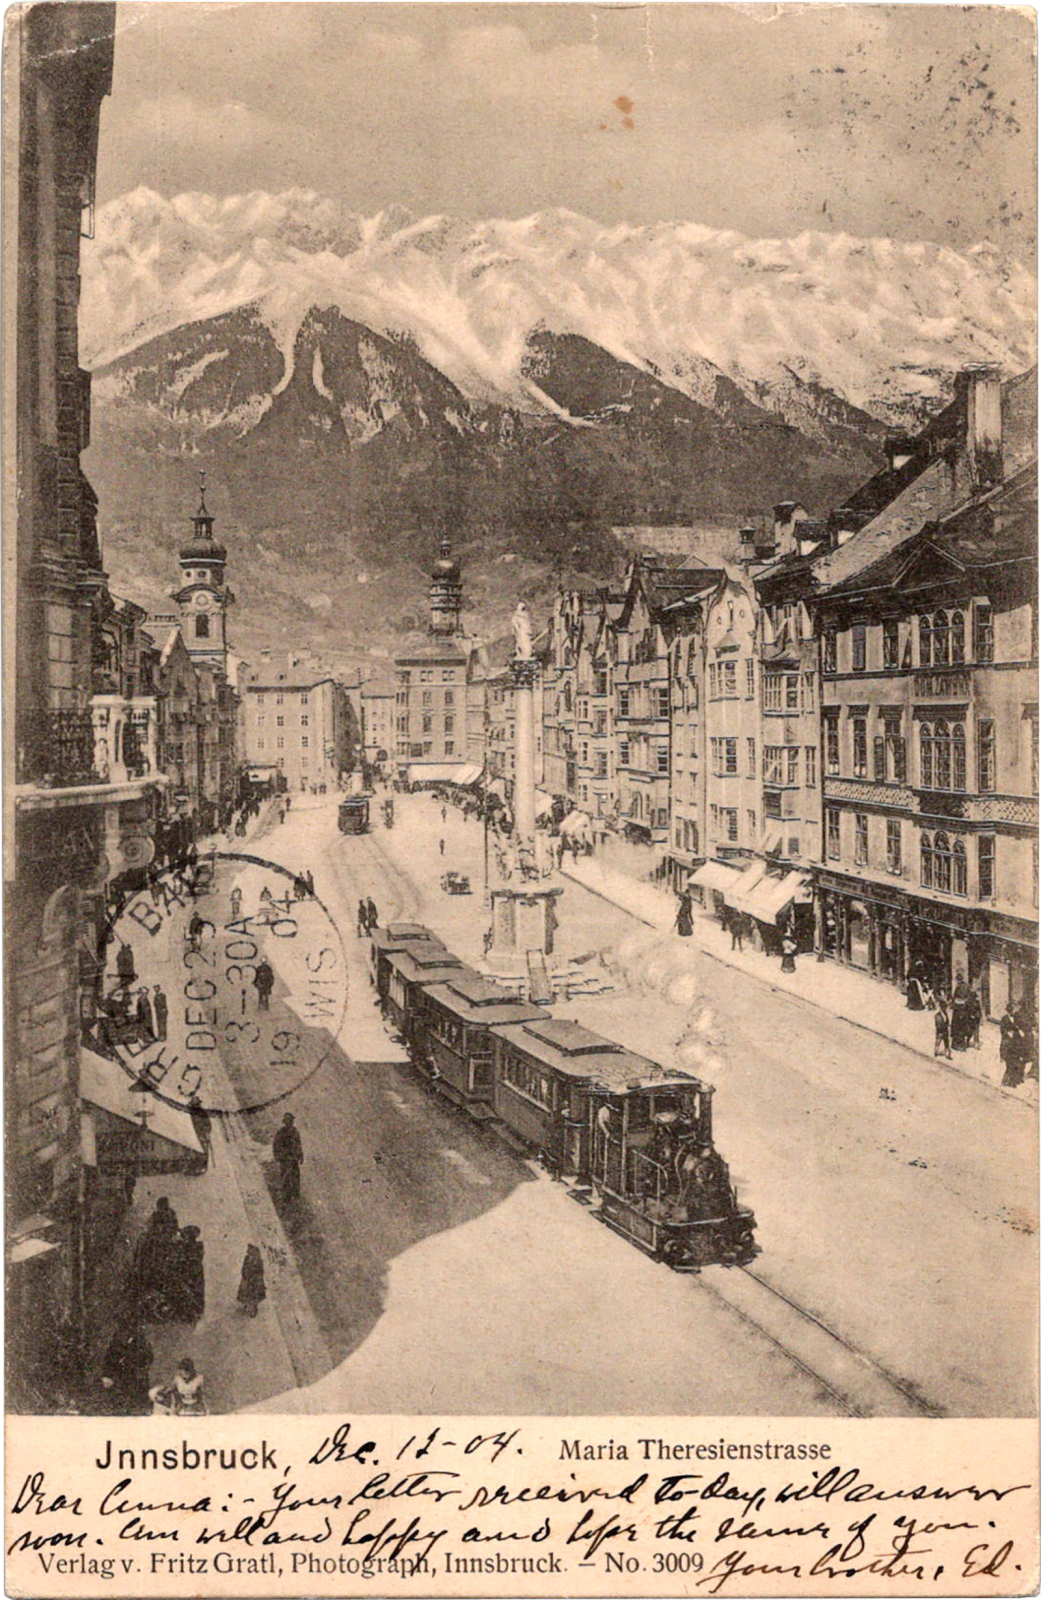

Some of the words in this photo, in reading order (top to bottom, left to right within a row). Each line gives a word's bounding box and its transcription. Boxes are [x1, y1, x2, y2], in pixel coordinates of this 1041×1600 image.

[11, 1471, 83, 1516] Dear
[347, 1471, 462, 1506] letter
[262, 1517, 332, 1546] and
[341, 1508, 448, 1577] happy
[461, 1517, 551, 1543] and
[655, 1506, 701, 1543] the
